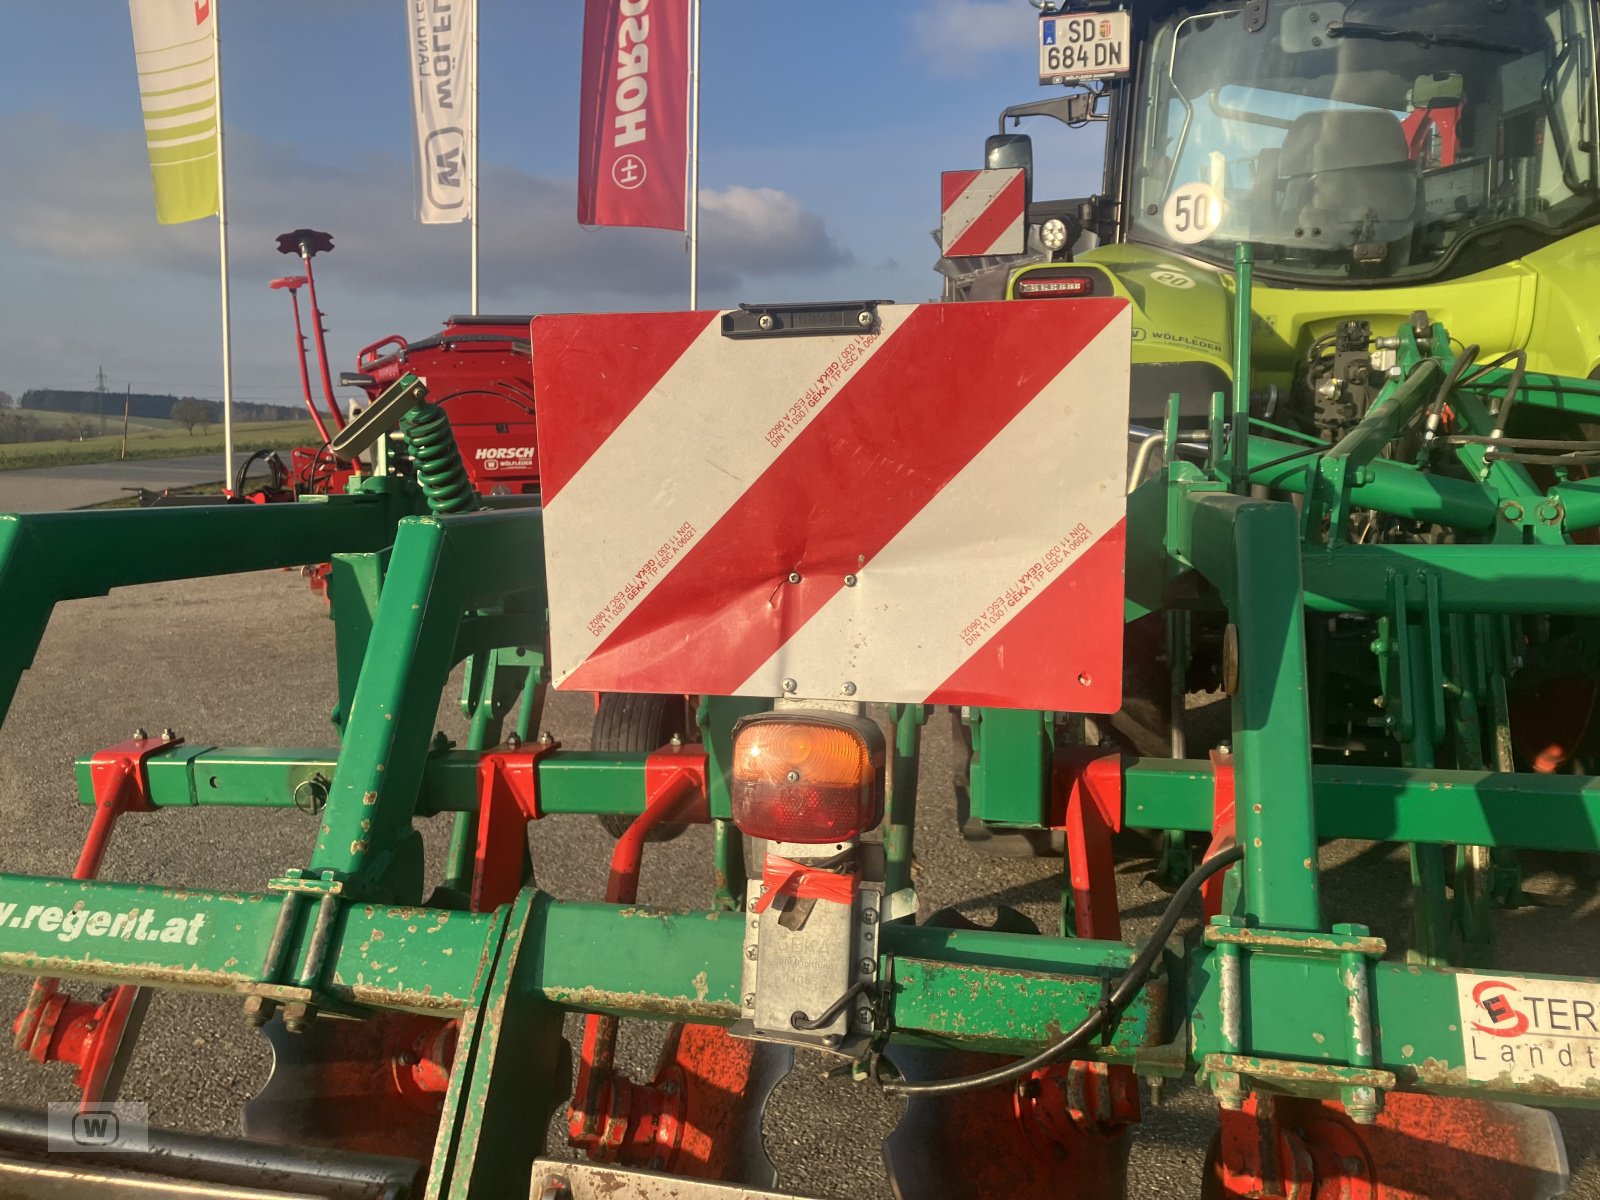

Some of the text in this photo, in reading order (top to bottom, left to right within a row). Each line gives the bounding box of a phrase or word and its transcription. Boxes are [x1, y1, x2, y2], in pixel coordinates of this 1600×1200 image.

[1068, 18, 1096, 43] SD
[1046, 36, 1053, 44] A
[1048, 41, 1122, 70] 684 DN
[1175, 193, 1209, 232] 50
[1156, 272, 1189, 287] 20
[841, 343, 855, 359] 030
[817, 362, 839, 384] GEKA
[771, 432, 785, 448] DIN
[784, 424, 794, 433] 11
[792, 411, 805, 425] 030
[808, 386, 830, 408] GEKA
[831, 370, 842, 382] TP
[841, 354, 858, 372] ESC
[806, 388, 816, 400] TP
[789, 397, 806, 415] ESC
[764, 421, 785, 442] 06021
[475, 447, 535, 459] HORSCH
[677, 521, 691, 536] DIN
[1069, 523, 1086, 538] DIN
[669, 535, 678, 544] 11
[1060, 538, 1070, 547] 11
[658, 543, 671, 557] 030
[1046, 546, 1060, 560] 030
[635, 559, 655, 579] GEKA
[1018, 563, 1042, 584] GEKA
[593, 622, 606, 637] DIN
[605, 615, 614, 624] 11
[612, 603, 625, 616] 030
[627, 581, 648, 600] GEKA
[649, 567, 658, 577] TP
[658, 552, 673, 569] ESC
[677, 527, 697, 547] 06021
[625, 582, 634, 593] TP
[965, 631, 981, 646] DIN
[980, 623, 990, 632] 11
[989, 609, 1005, 624] 030
[1007, 586, 1032, 607] GEKA
[1033, 571, 1045, 582] TP
[1044, 556, 1063, 573] ESC
[1069, 529, 1092, 550] 06021
[610, 591, 625, 608] ESC
[1006, 587, 1017, 599] TP
[987, 597, 1005, 614] ESC
[586, 612, 605, 631] 06021
[960, 619, 981, 640] 06021
